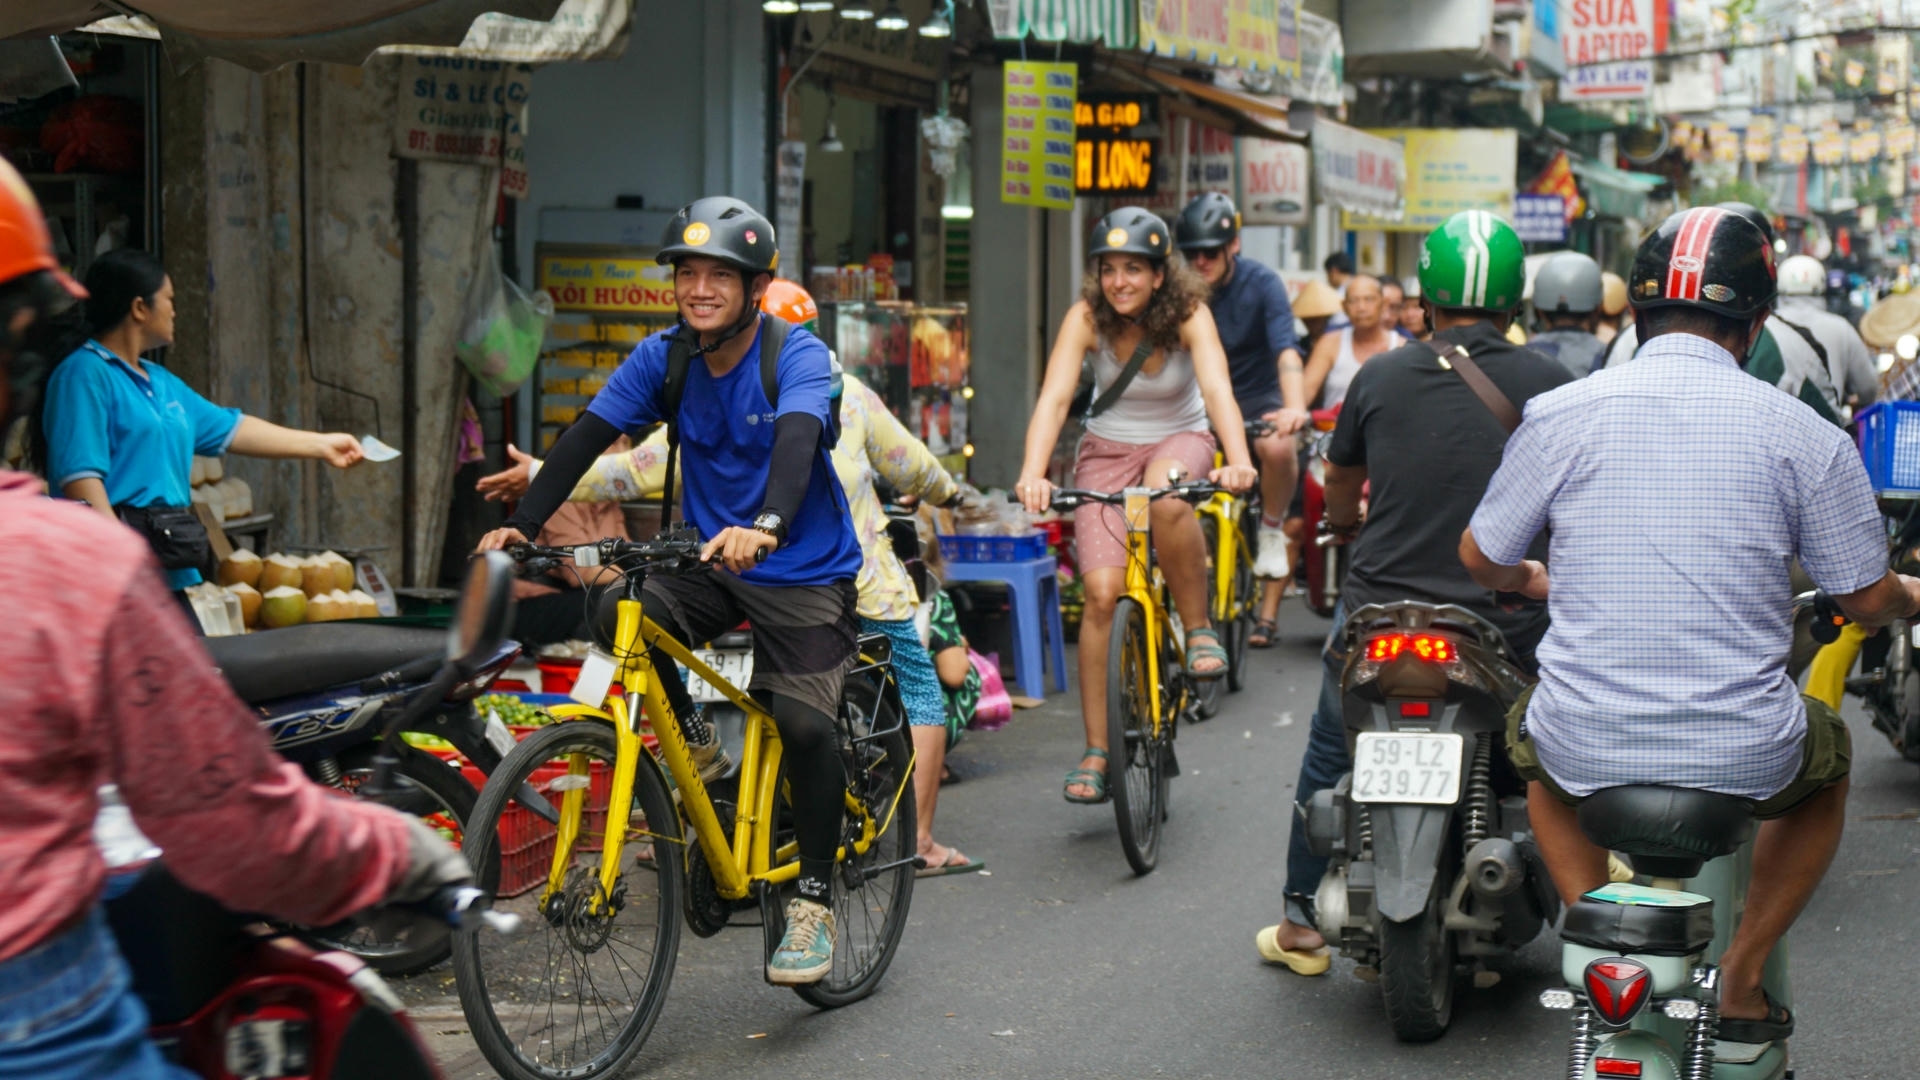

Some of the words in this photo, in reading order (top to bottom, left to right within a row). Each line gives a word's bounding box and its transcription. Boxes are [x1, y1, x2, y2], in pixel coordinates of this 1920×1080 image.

[1562, 32, 1648, 65] LAPTOP
[445, 82, 460, 101] &
[1097, 102, 1141, 133] GẠO
[1097, 140, 1151, 189] LONG
[687, 229, 706, 241] 07
[548, 281, 586, 304] XÔI
[1373, 739, 1445, 767] 59-L2
[1359, 769, 1450, 798] 239.77
